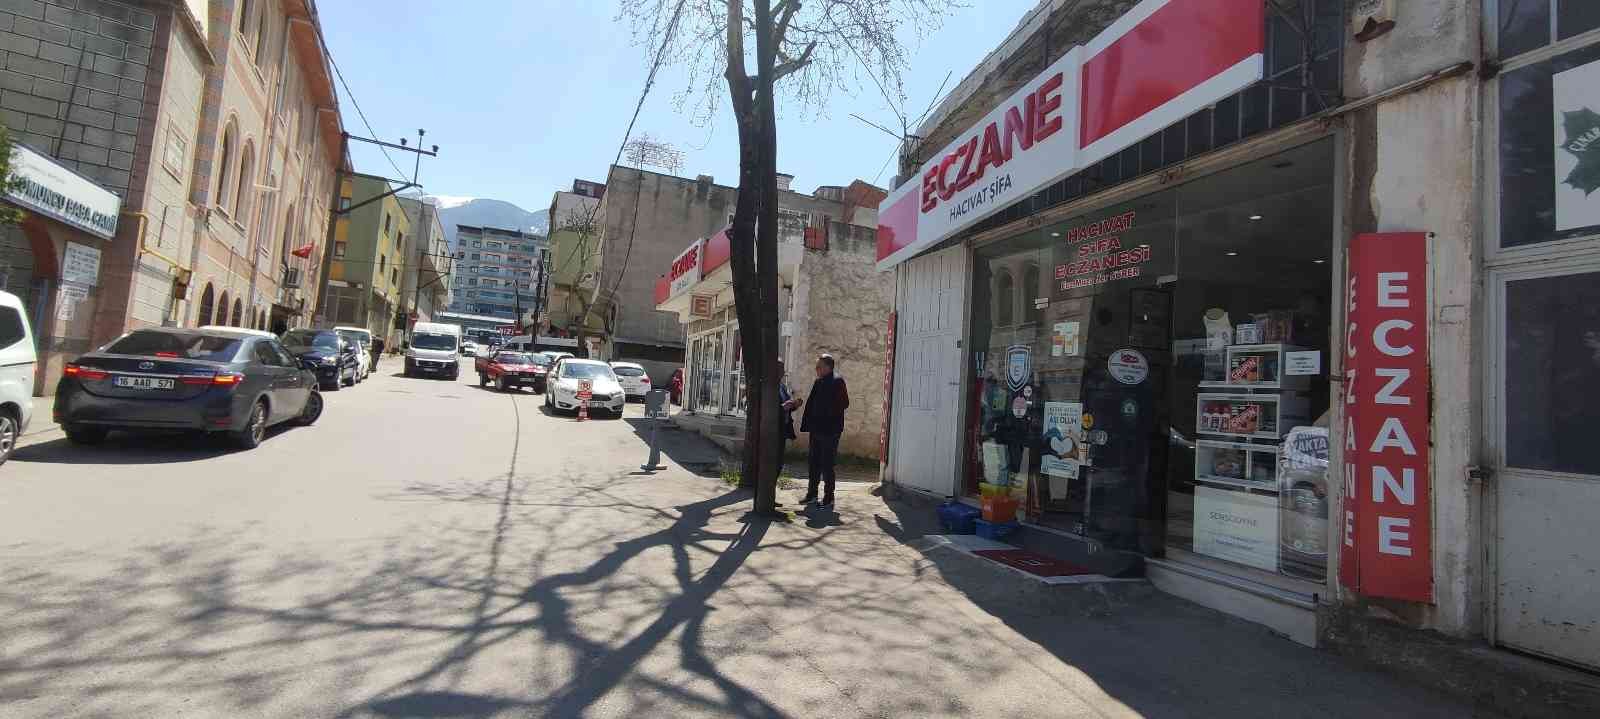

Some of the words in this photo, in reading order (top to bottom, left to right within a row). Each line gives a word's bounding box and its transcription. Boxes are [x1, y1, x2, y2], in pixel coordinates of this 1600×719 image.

[920, 71, 1064, 214] ECZANE
[950, 187, 988, 222] HACIVAT
[989, 172, 1013, 204] ŞİFA
[120, 377, 128, 386] 16
[1344, 275, 1358, 547] ECZANE
[1369, 271, 1417, 557] ECZANE
